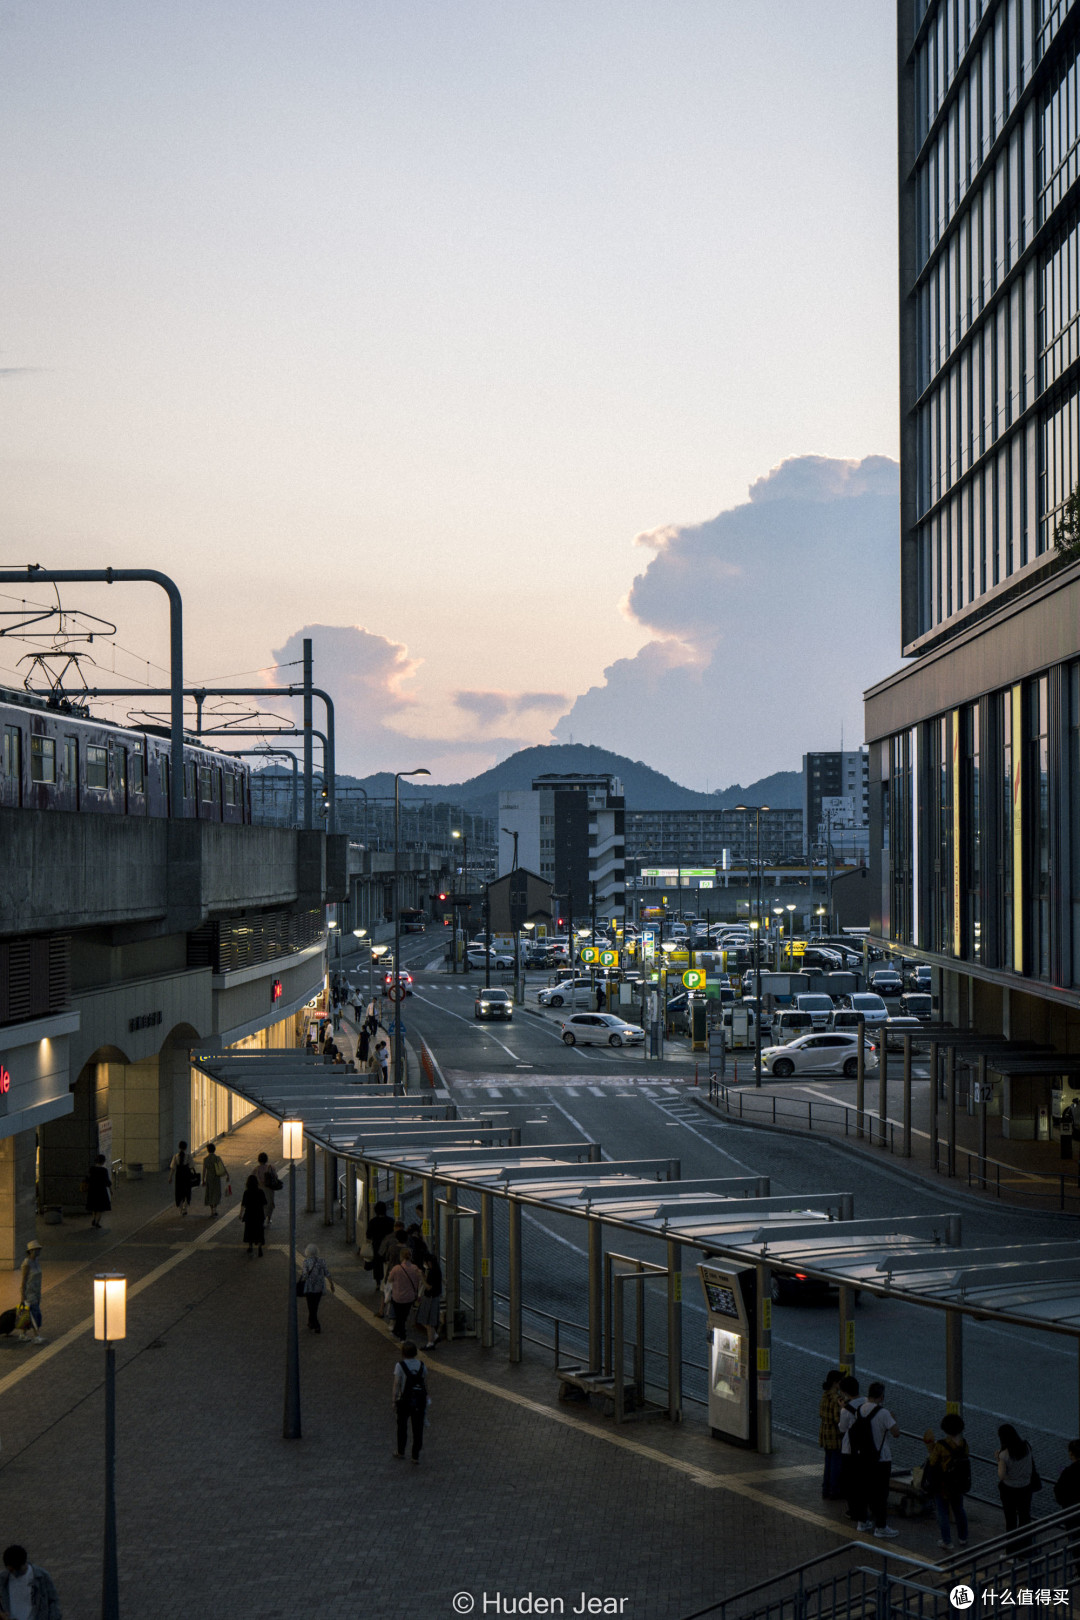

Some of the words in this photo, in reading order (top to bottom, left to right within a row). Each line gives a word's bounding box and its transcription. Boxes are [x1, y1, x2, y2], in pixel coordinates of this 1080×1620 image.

[643, 932, 653, 941] P
[585, 950, 593, 961] P
[604, 953, 613, 964] P
[688, 973, 699, 987] P
[980, 1087, 991, 1101] 12
